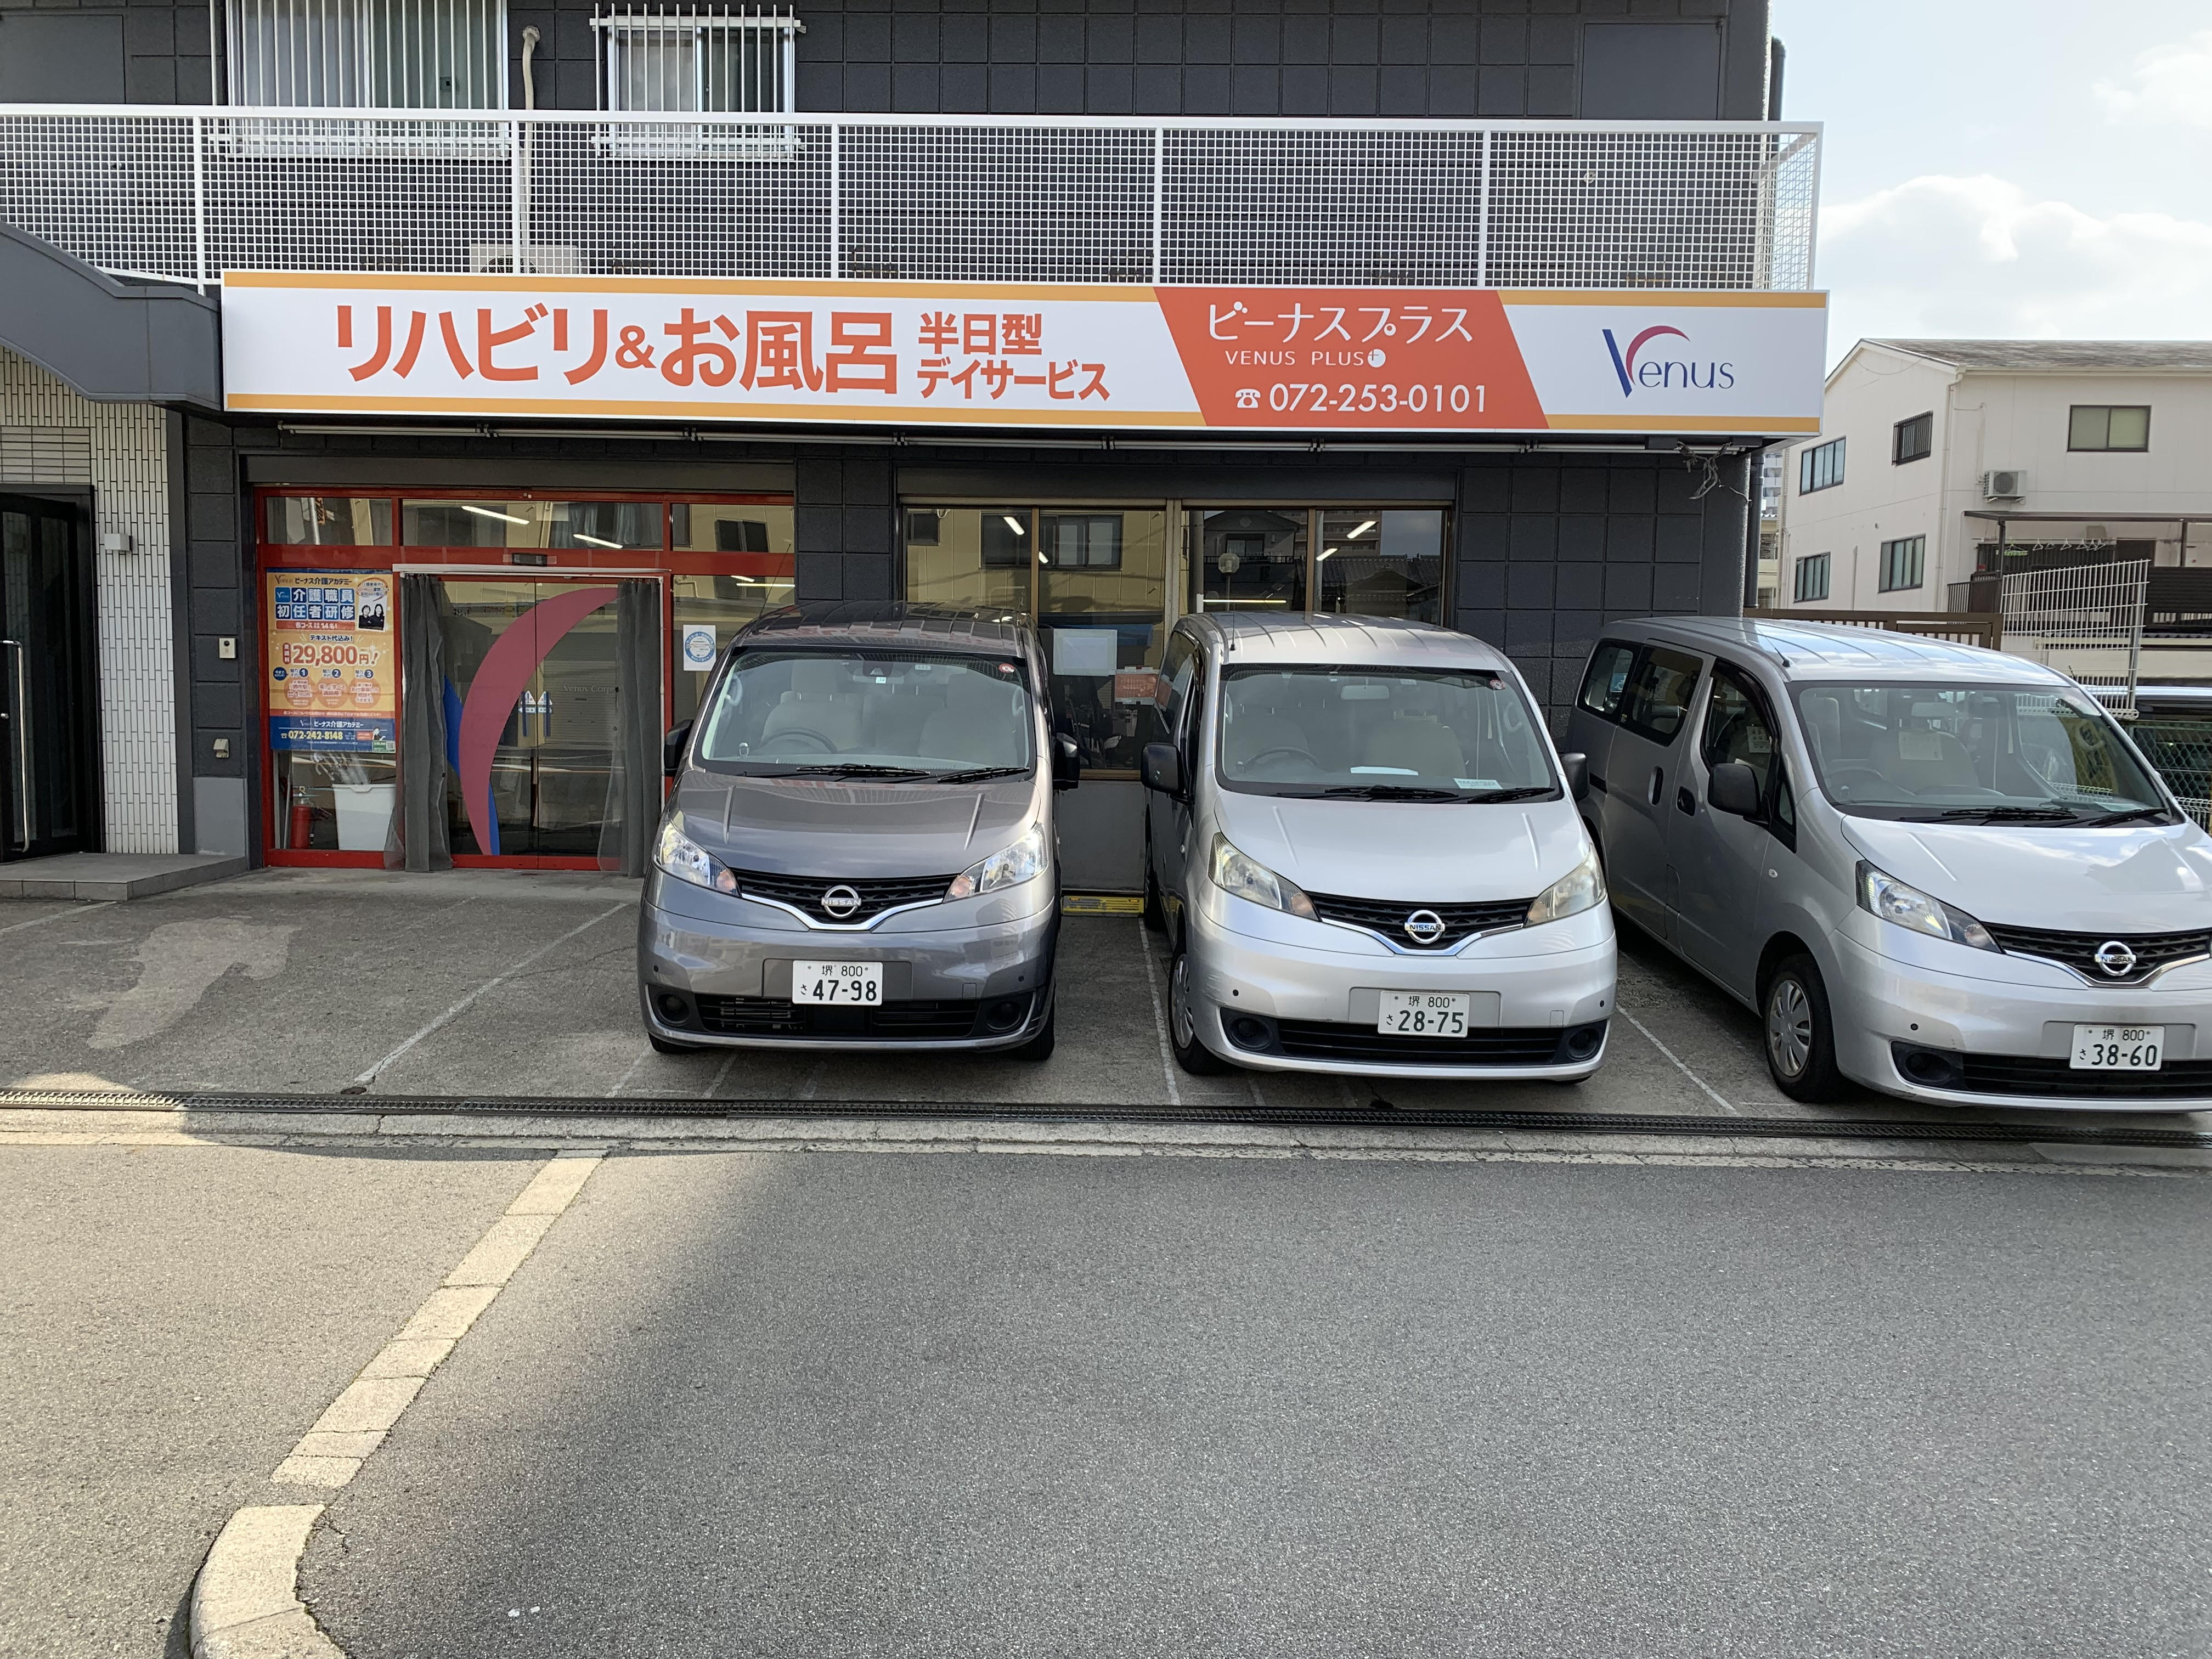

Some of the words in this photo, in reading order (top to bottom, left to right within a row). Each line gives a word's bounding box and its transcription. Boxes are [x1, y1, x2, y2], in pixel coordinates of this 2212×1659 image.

[918, 311, 1043, 356] 半日型
[1209, 301, 1473, 344] ビーナスプラス
[337, 302, 898, 394] リハビリ&お風呂
[1225, 350, 1295, 365] VENUS
[1311, 351, 1364, 366] PLUS
[1602, 325, 1734, 398] Venus
[917, 356, 1111, 401] デイサービス
[1269, 383, 1486, 413] 072-253-0101
[293, 588, 353, 603] 介護職員
[277, 605, 354, 620] 初任者研修
[288, 730, 343, 740] 072-242-8148
[821, 965, 833, 977] 堺
[841, 966, 863, 977] 800
[812, 979, 877, 1001] 47-98
[1408, 996, 1420, 1007] 堺
[1427, 997, 1450, 1008] 800
[1398, 1010, 1464, 1034] 28-75
[2102, 1029, 2114, 1041] 堺
[2122, 1030, 2145, 1041] 800
[2091, 1043, 2158, 1066] 38-60
